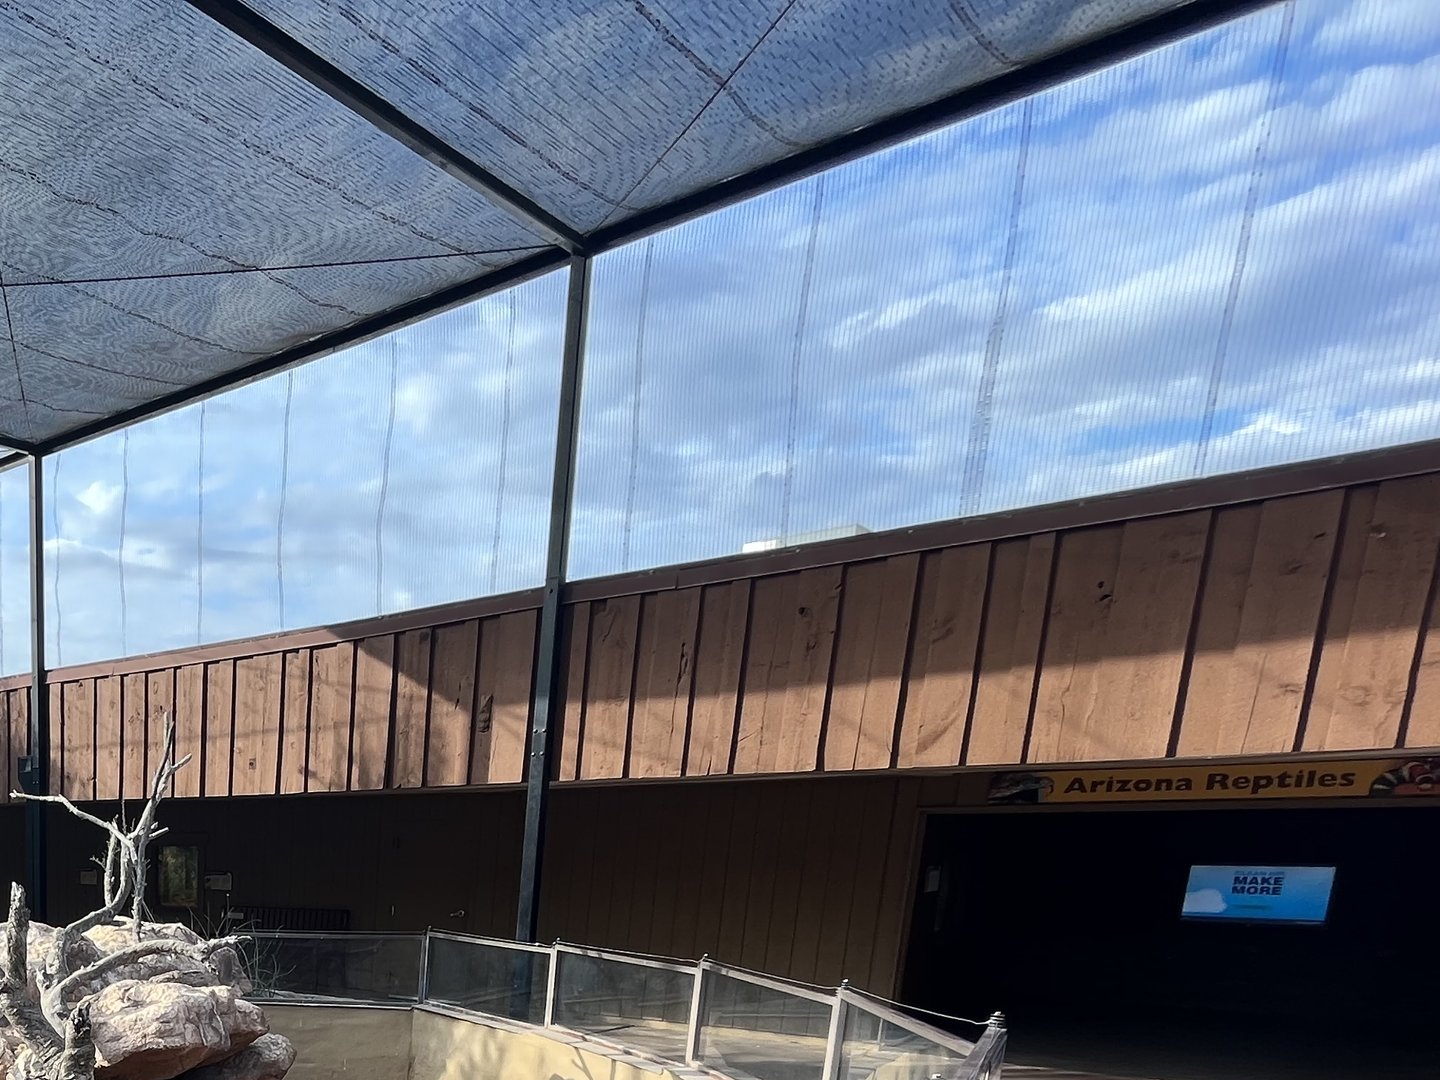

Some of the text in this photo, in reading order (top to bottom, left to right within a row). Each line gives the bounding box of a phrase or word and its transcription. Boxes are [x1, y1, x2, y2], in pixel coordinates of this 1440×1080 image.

[1064, 770, 1356, 795] Arizona Reptiles
[1233, 876, 1285, 885] MAKE
[1232, 886, 1283, 895] MORE
